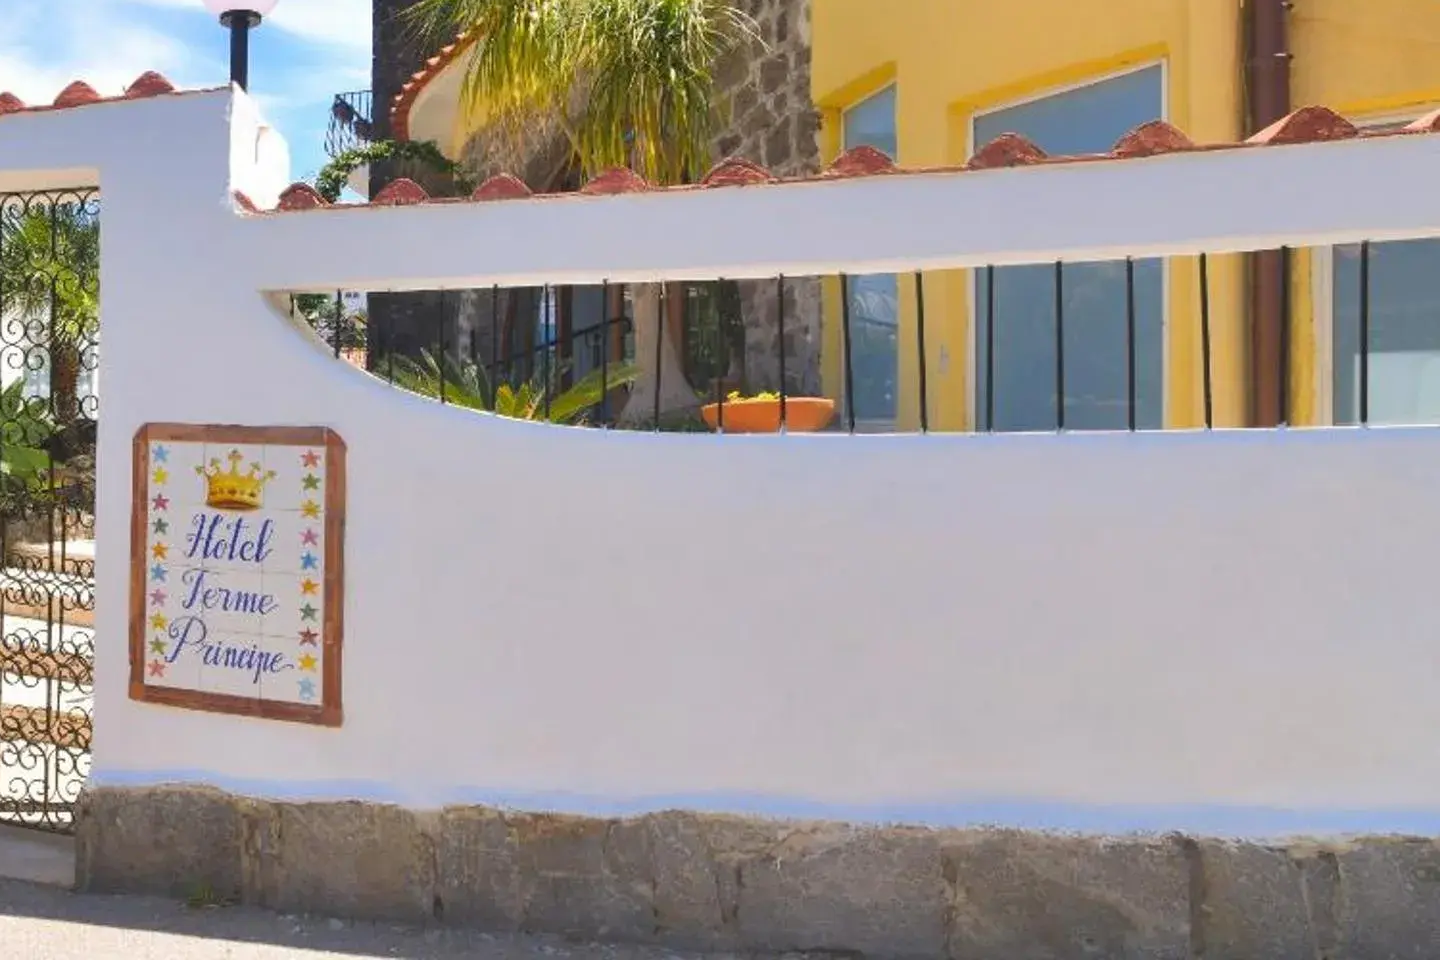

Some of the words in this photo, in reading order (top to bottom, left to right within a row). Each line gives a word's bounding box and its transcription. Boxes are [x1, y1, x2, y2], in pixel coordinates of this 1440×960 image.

[184, 513, 273, 563] Hotel
[181, 567, 280, 616] Terme
[164, 615, 295, 685] Principe
